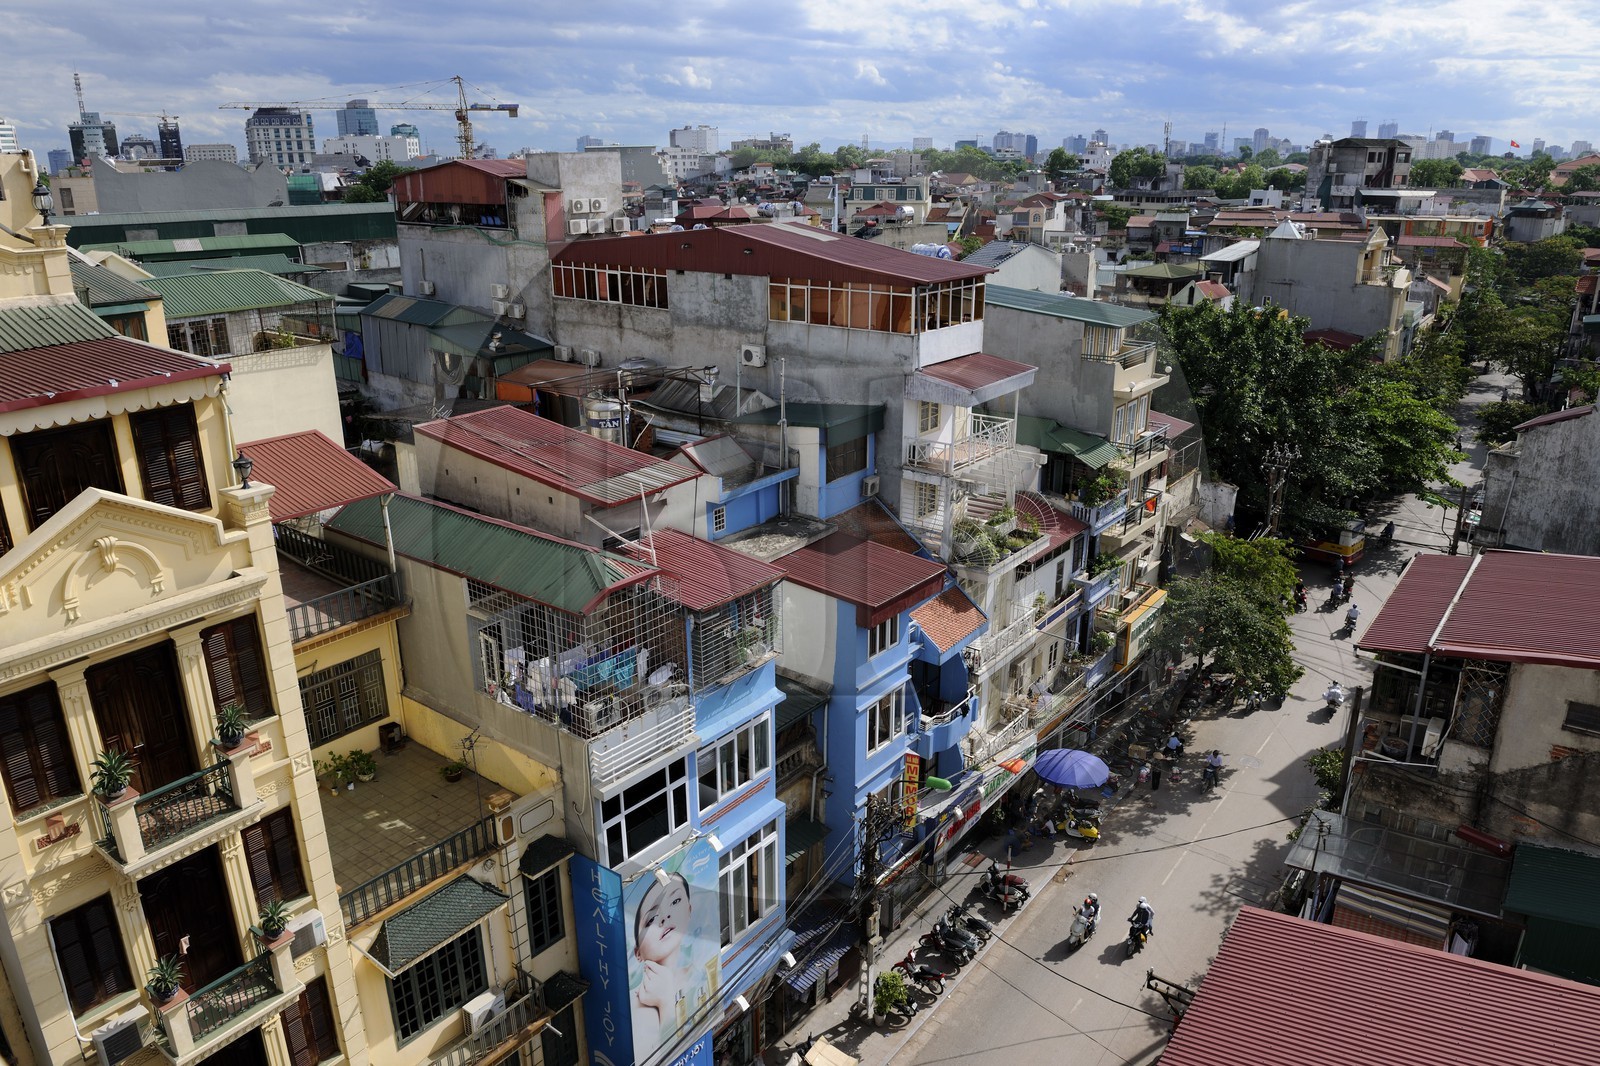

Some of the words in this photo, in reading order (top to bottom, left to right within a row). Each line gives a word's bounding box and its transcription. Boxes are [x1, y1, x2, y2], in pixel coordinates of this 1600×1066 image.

[905, 765, 919, 826] MEMORY
[591, 868, 609, 990] HEALTHY
[603, 1001, 615, 1047] JOY
[690, 1041, 705, 1058] JOY
